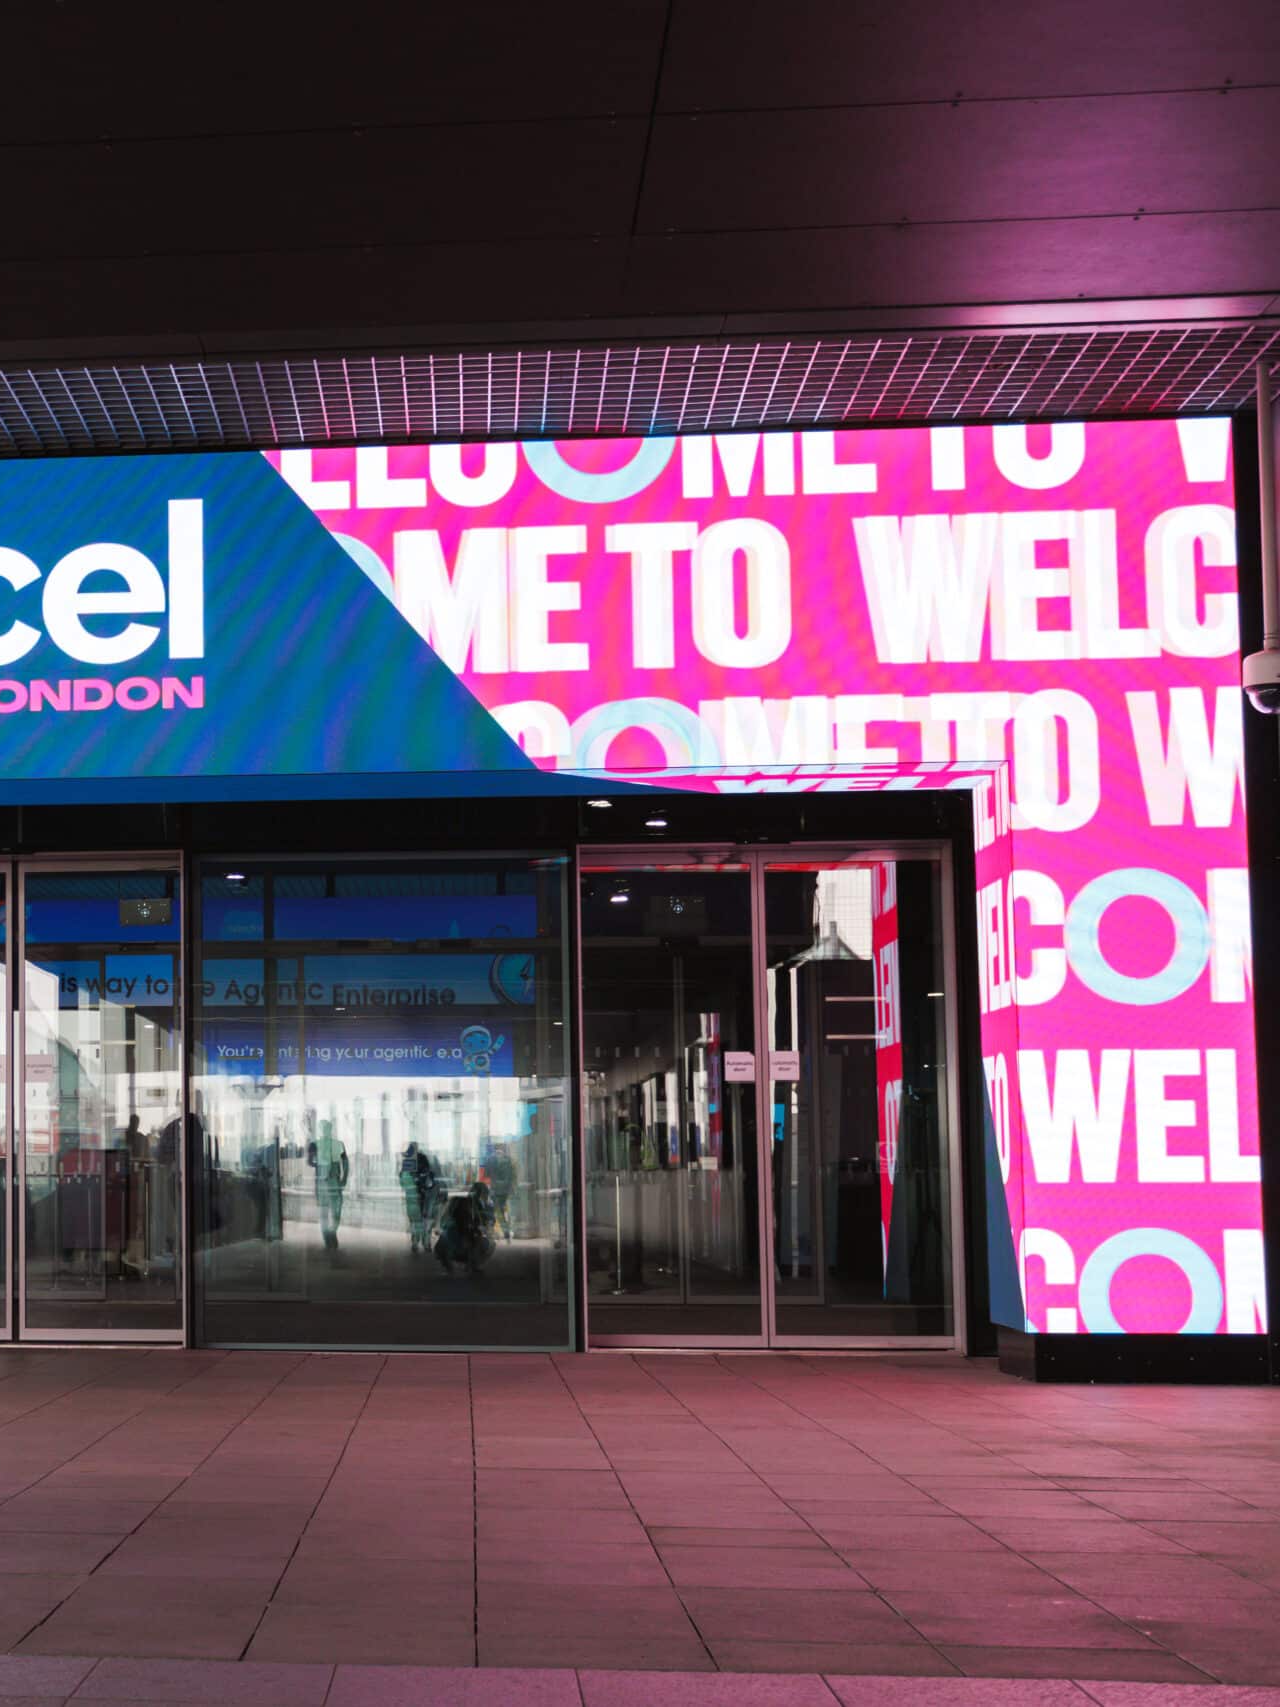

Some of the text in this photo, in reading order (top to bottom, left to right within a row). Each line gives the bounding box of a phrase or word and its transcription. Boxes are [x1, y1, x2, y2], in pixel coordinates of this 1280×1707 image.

[329, 525, 590, 675] ME
[605, 516, 792, 669] TO
[60, 972, 78, 993] is
[145, 974, 169, 995] to
